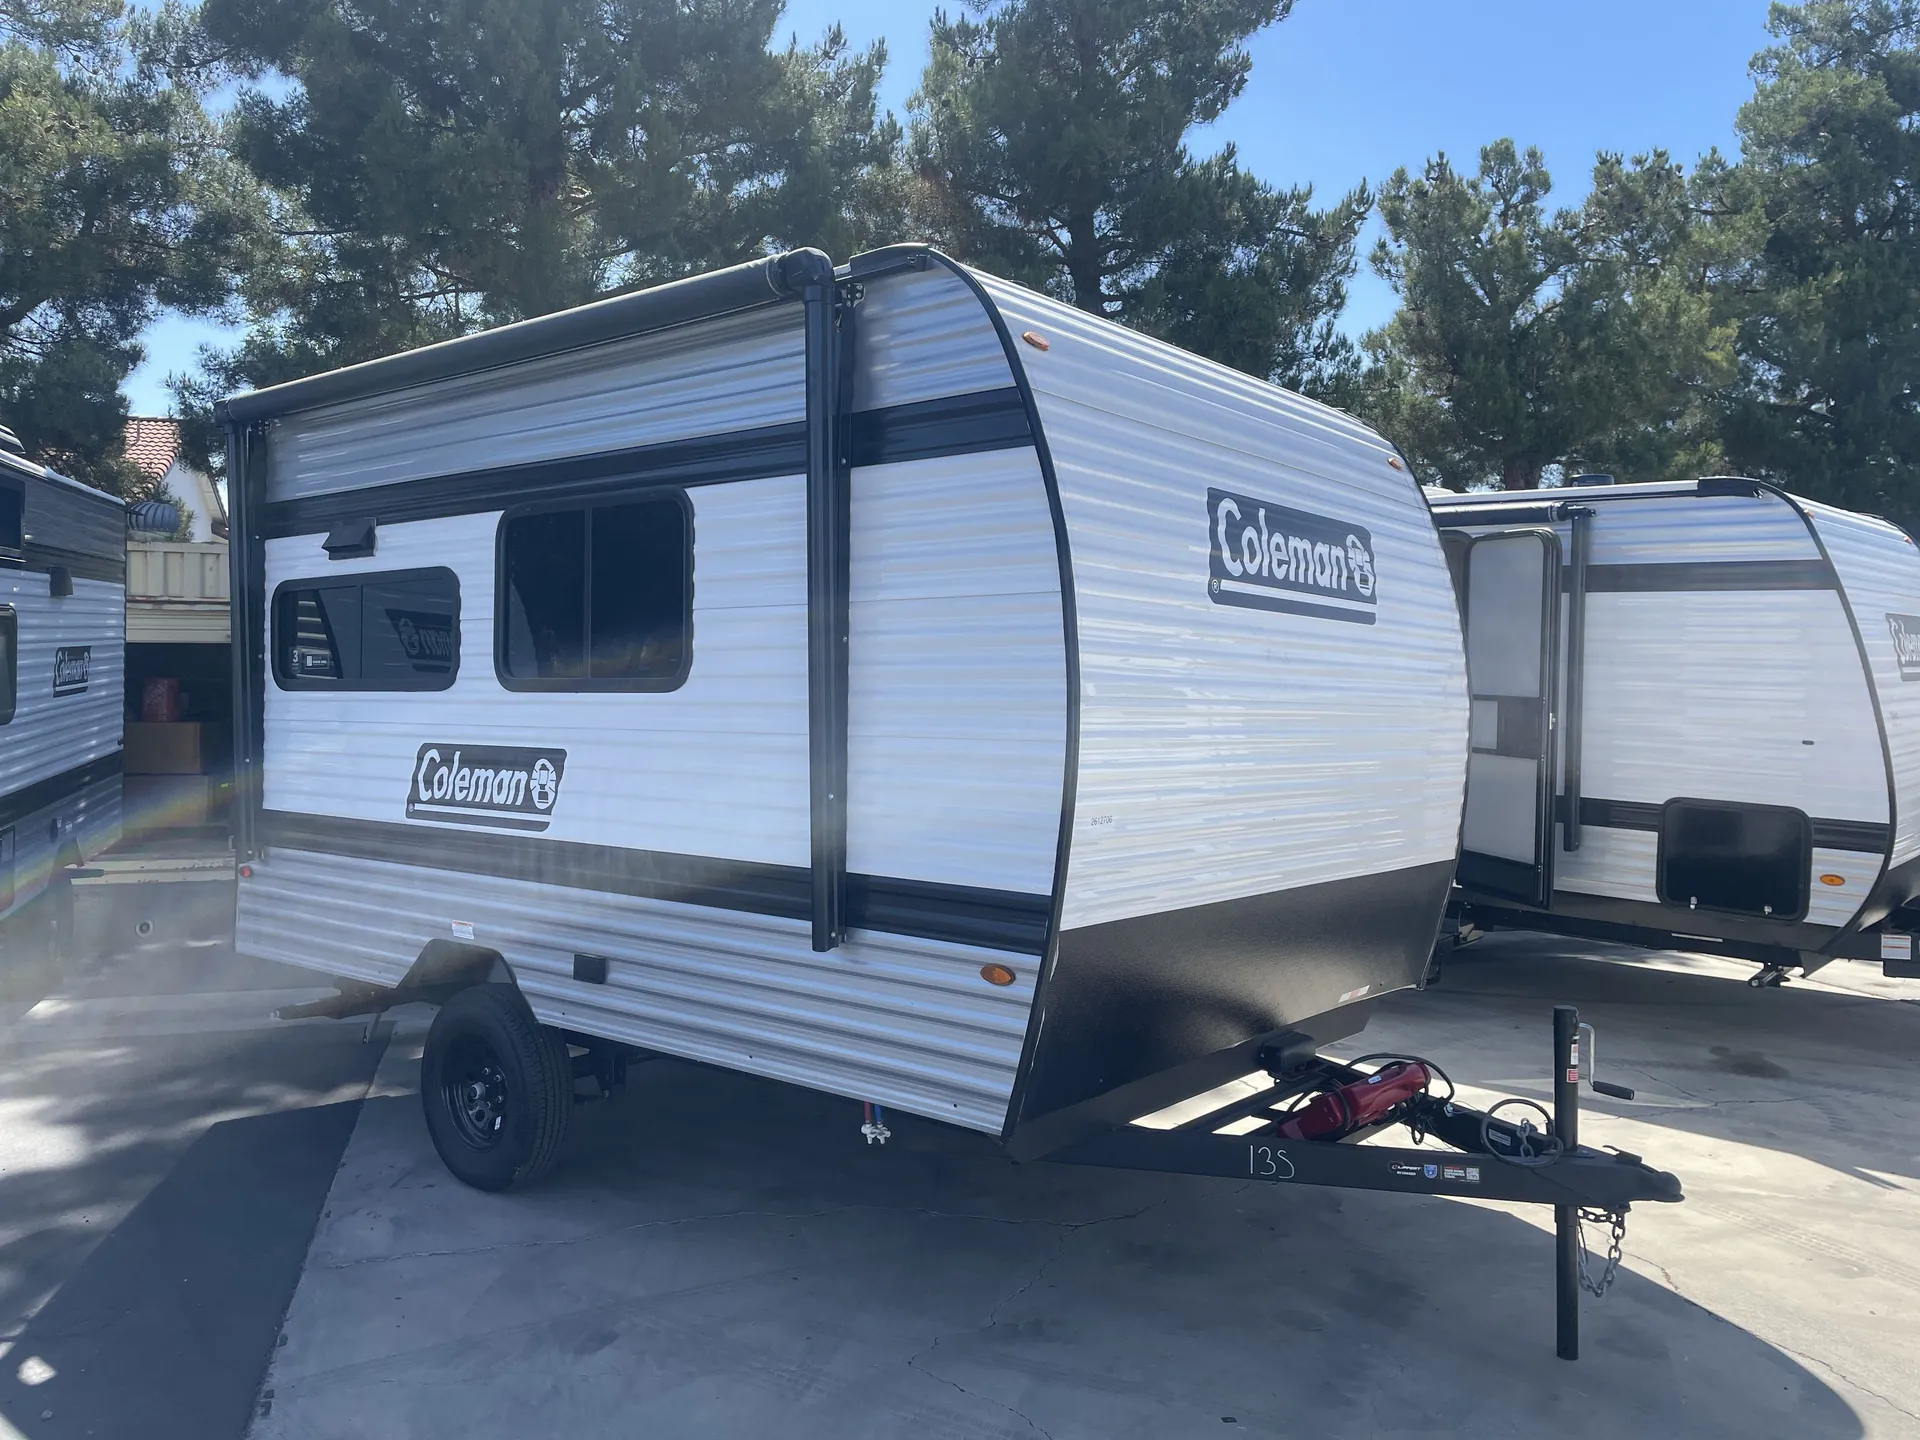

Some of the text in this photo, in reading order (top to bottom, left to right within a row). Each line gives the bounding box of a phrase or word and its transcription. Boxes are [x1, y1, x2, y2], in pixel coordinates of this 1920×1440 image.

[1217, 497, 1347, 591] Coleman
[55, 650, 83, 685] Coleman
[292, 649, 299, 663] 3
[417, 748, 528, 806] Coleman
